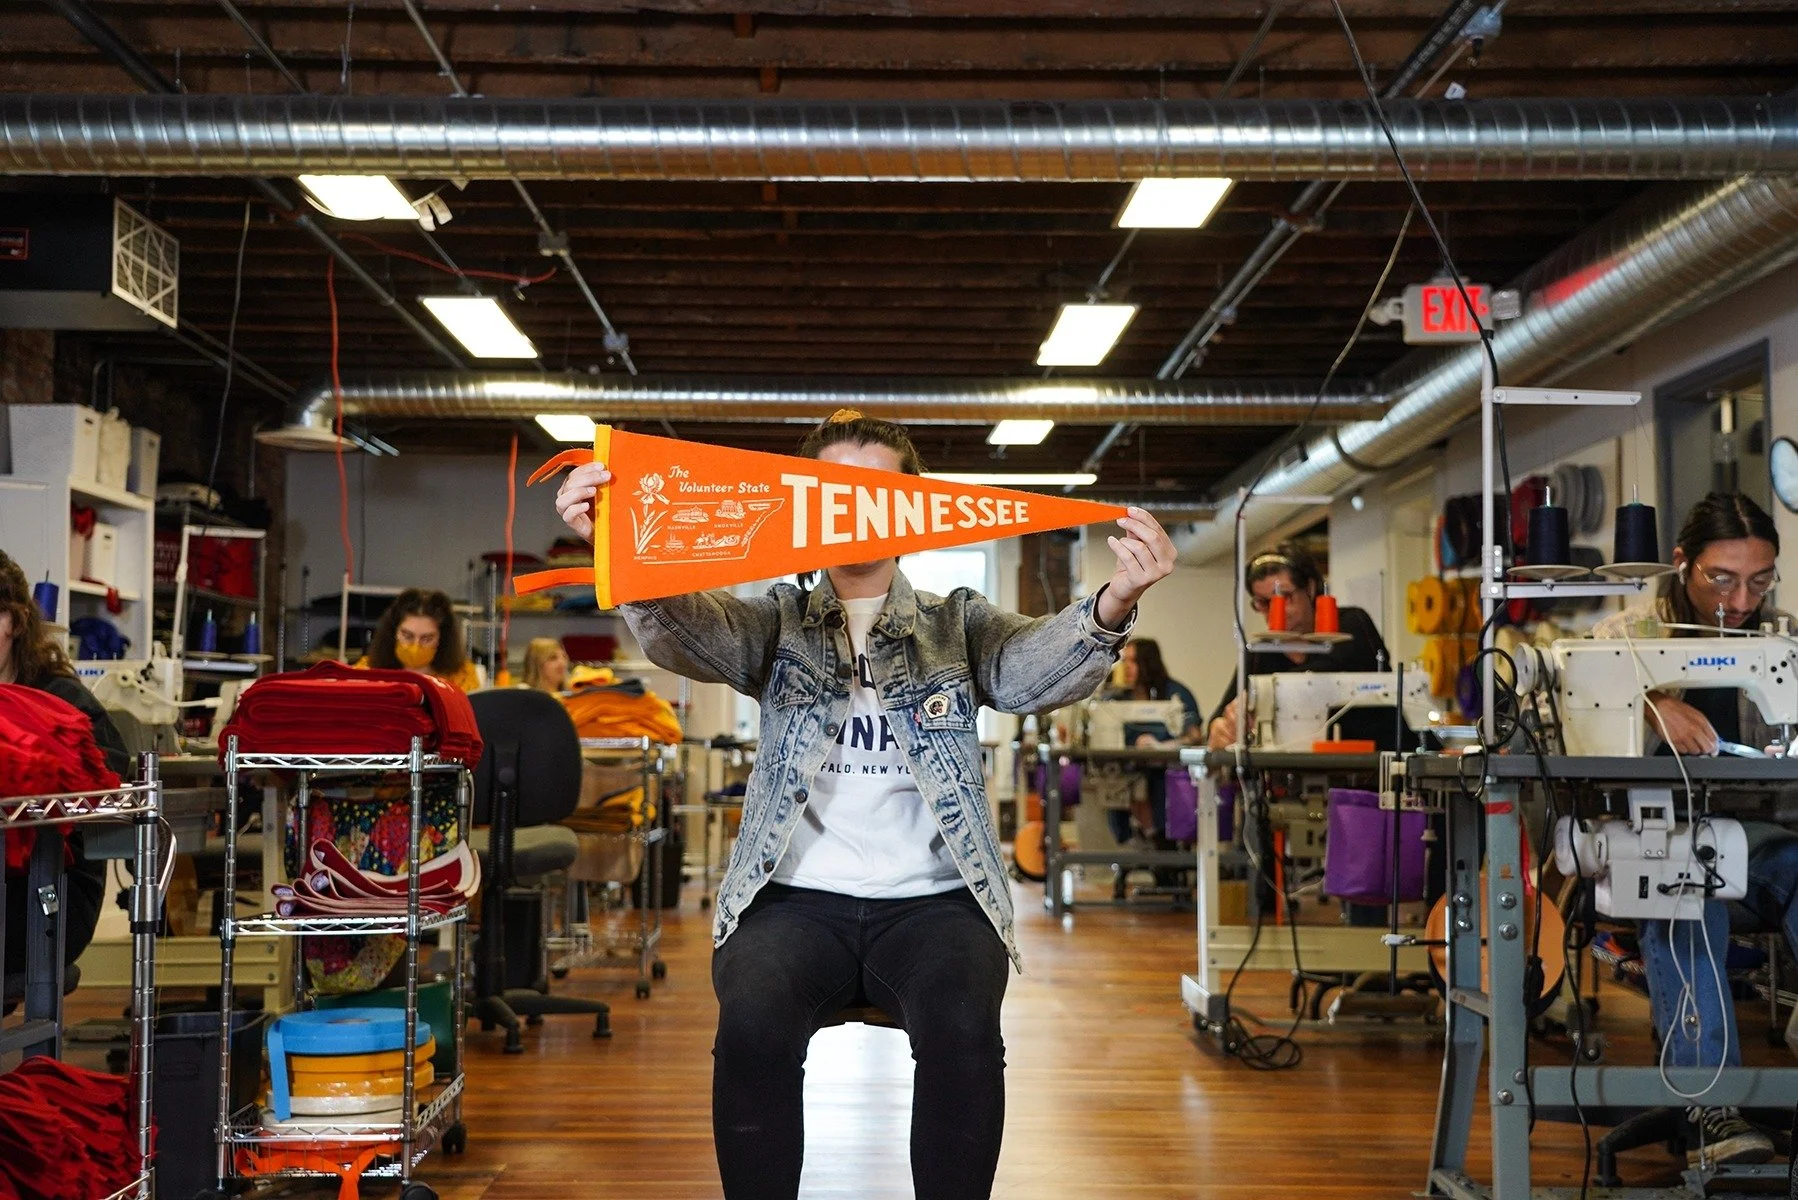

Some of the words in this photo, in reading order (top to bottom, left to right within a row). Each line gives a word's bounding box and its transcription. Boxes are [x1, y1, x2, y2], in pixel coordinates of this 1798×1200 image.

[1421, 286, 1482, 333] EXIT
[668, 465, 690, 478] The
[679, 481, 734, 494] Volunteer
[738, 481, 770, 494] State
[781, 473, 1030, 549] TENNESSEE
[1689, 657, 1736, 666] JUKI
[862, 765, 889, 775] NEW
